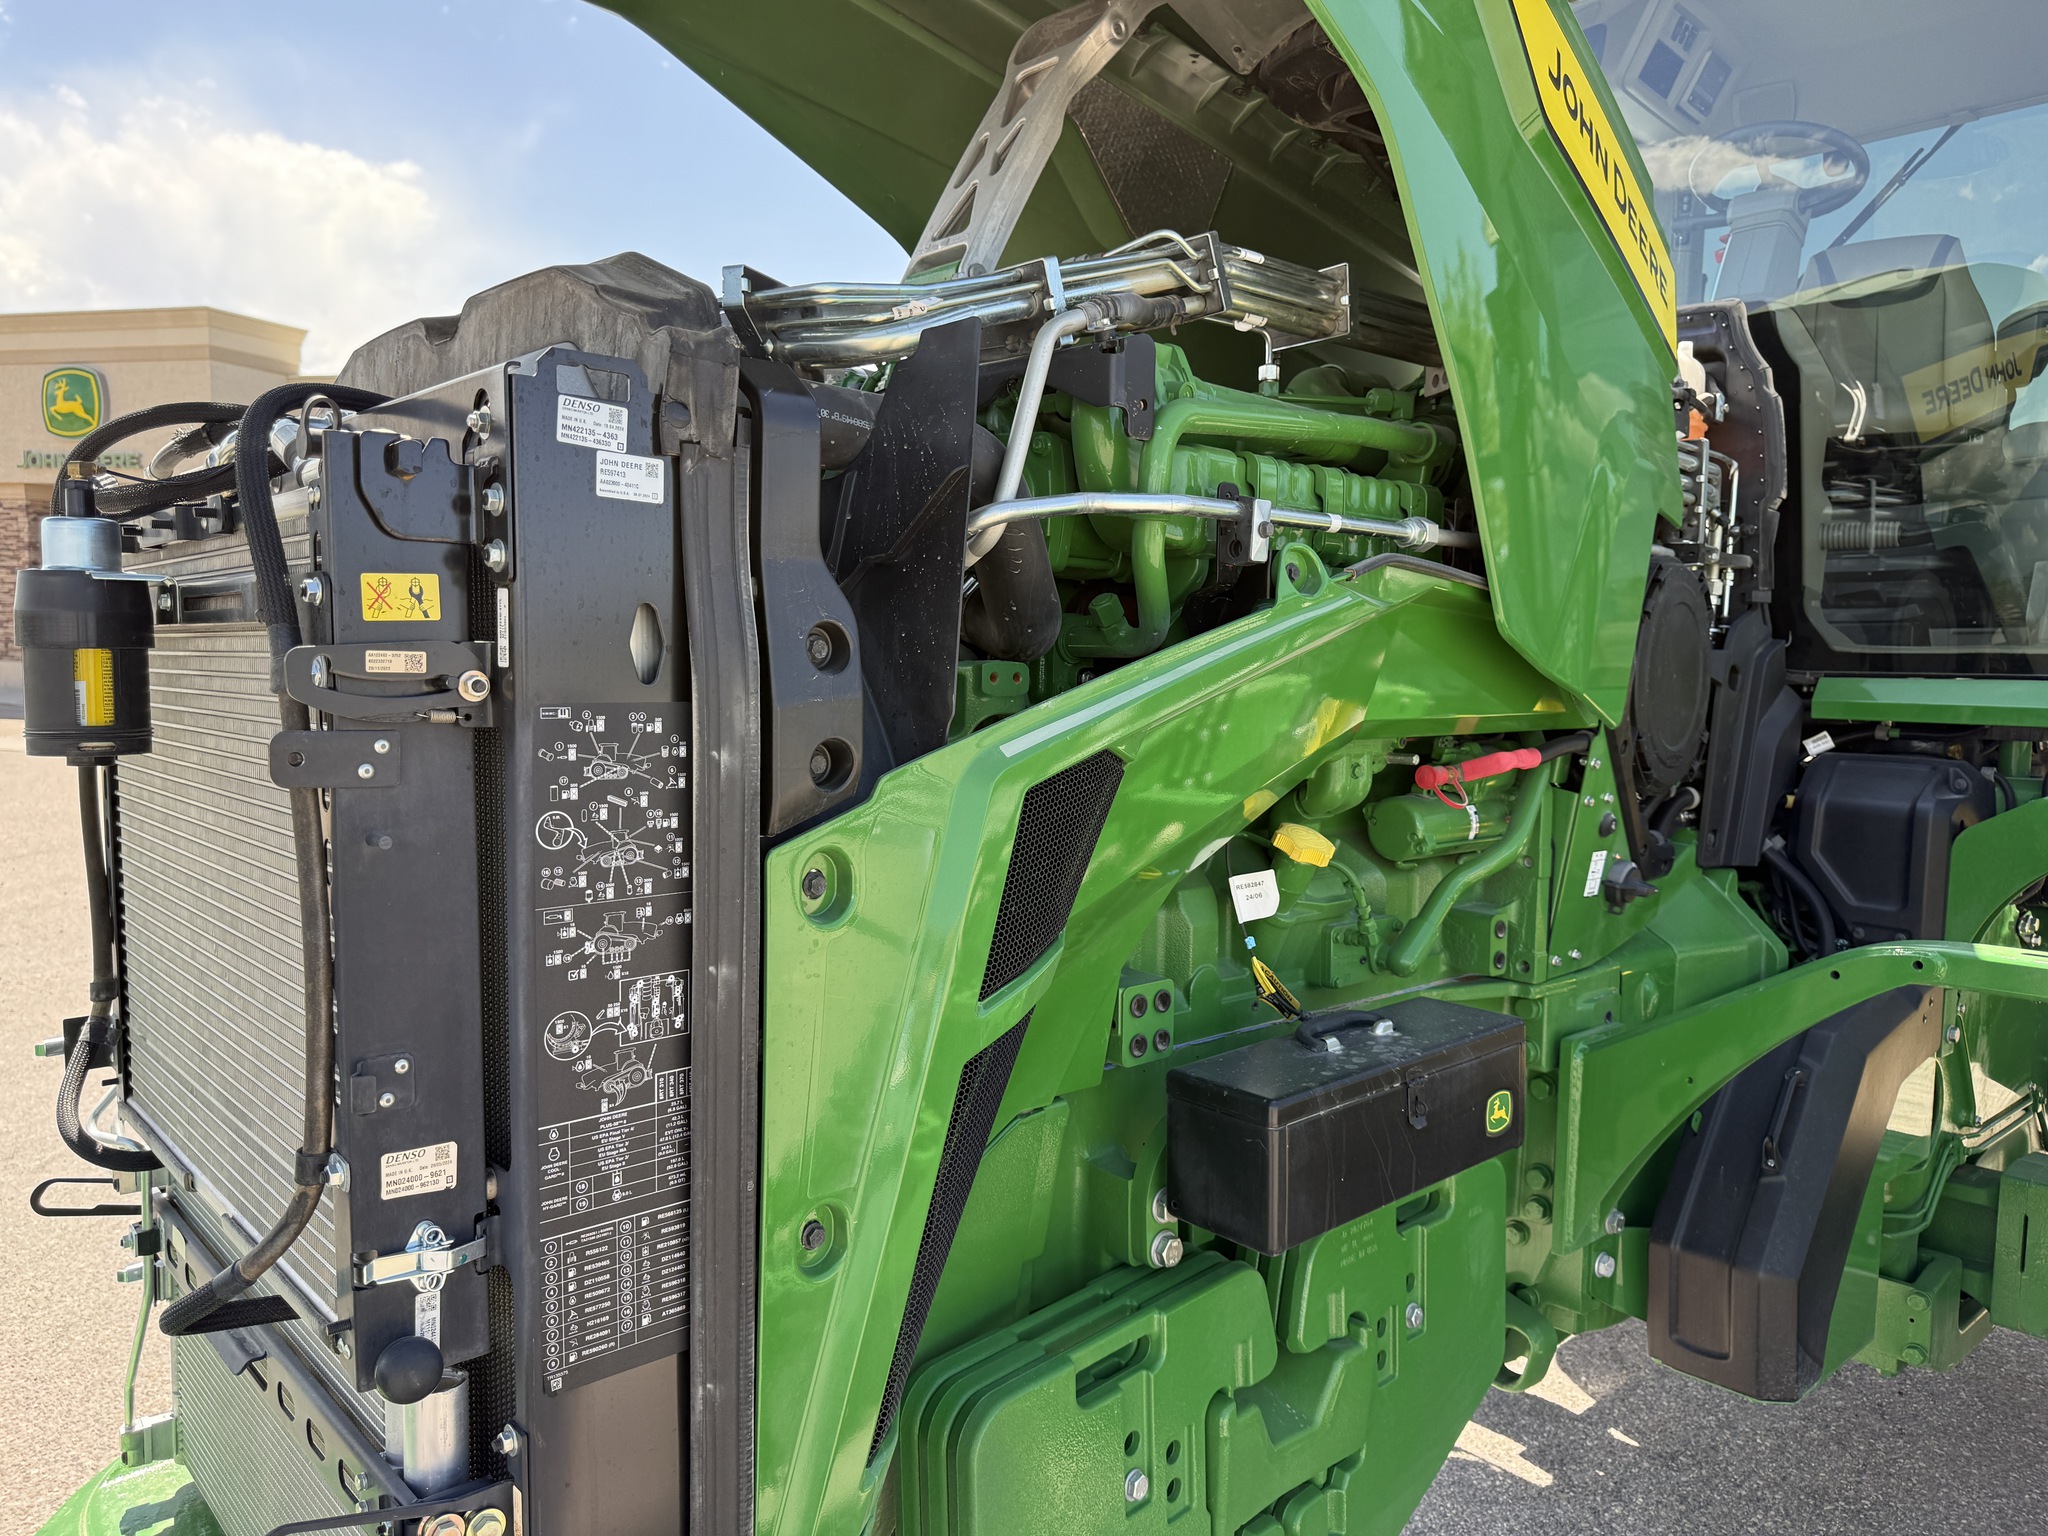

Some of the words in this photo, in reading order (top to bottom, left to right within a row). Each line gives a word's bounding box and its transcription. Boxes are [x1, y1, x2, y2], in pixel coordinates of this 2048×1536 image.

[1547, 46, 1609, 186] JOHN
[1613, 158, 1669, 311] DEERE
[562, 397, 601, 413] DENSO
[561, 414, 573, 422] MADE
[600, 458, 619, 467] JOHN
[621, 461, 643, 471] DEERE
[1235, 880, 1265, 891] RE582847
[1245, 892, 1263, 901] 24/06
[1264, 969, 1293, 1002] CAUTION
[598, 1115, 611, 1123] JOHN
[612, 1112, 628, 1120] DEERE
[385, 1148, 426, 1165] DENSO
[540, 1163, 553, 1171] JOHN
[553, 1160, 568, 1168] DEERE
[541, 1199, 554, 1207] JOHN
[554, 1195, 568, 1203] DEERE
